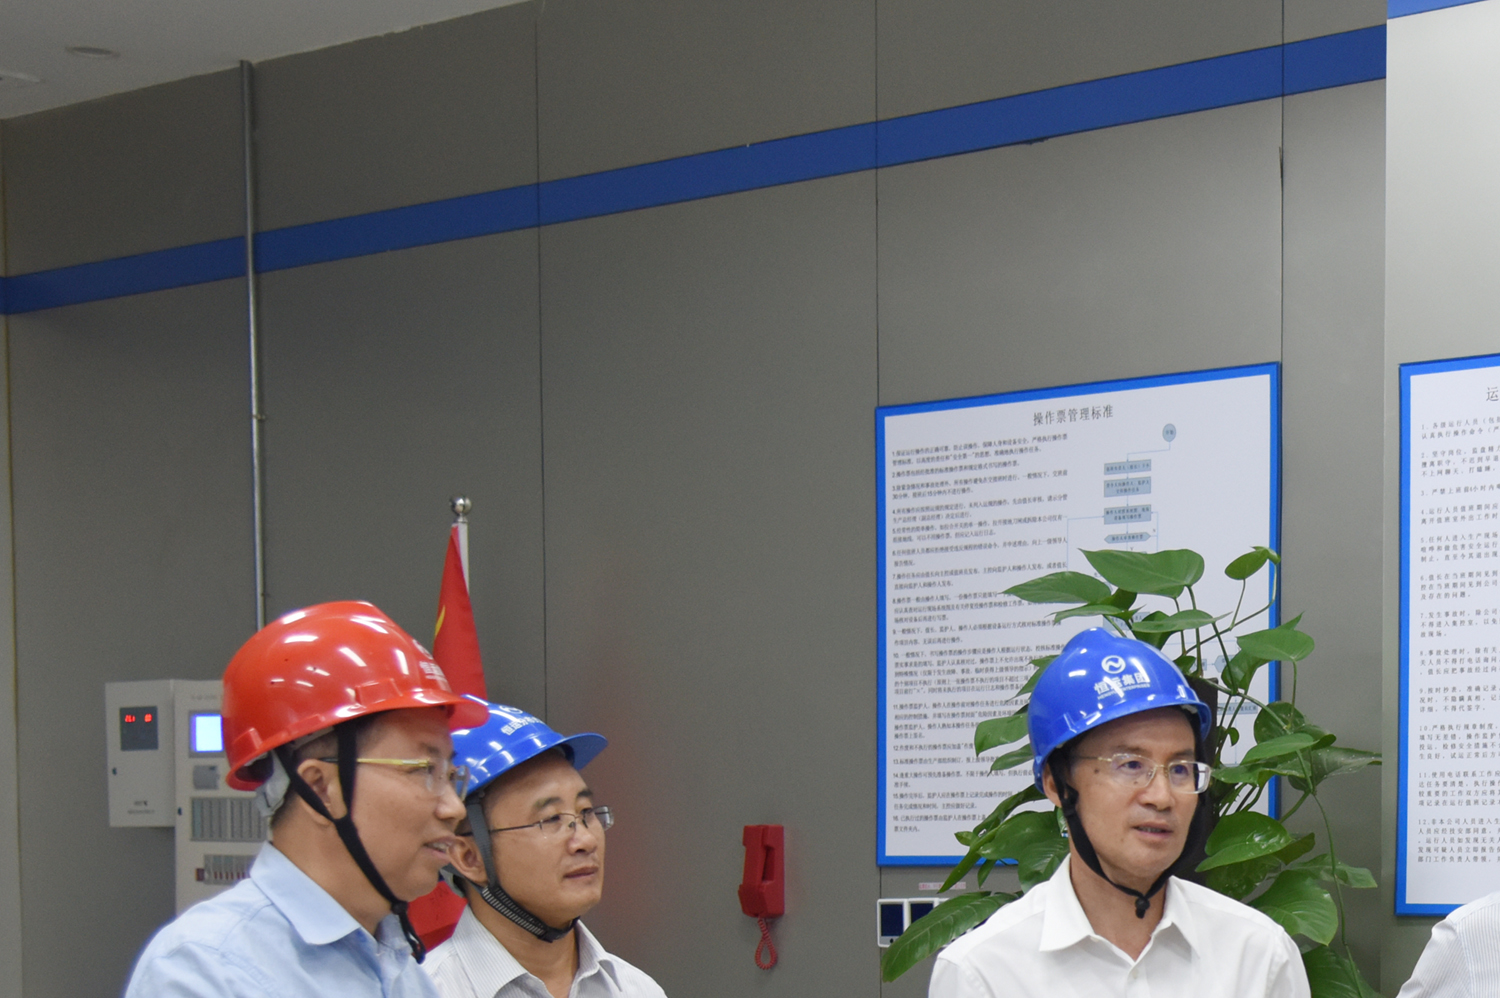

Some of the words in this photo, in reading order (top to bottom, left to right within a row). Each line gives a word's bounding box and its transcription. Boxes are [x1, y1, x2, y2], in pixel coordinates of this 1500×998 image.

[1032, 403, 1115, 427] 操作票管理标准
[1093, 672, 1151, 696] 恒运集团
